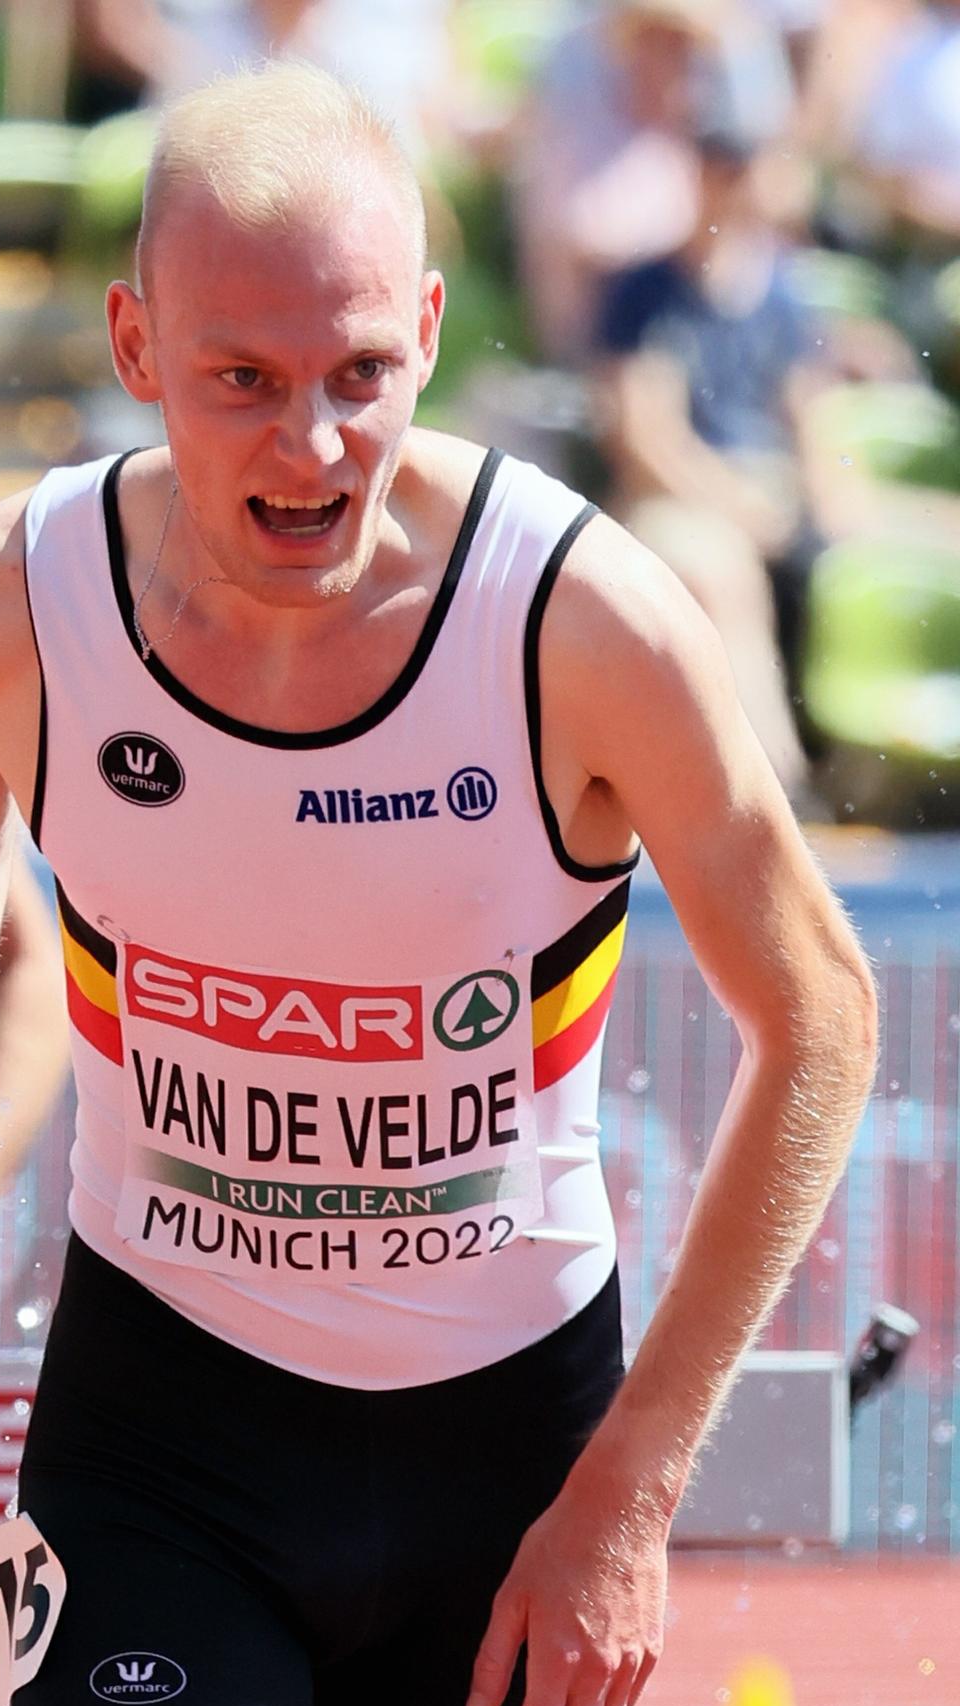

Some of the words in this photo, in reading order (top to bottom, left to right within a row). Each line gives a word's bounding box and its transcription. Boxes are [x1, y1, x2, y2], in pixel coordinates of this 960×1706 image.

[111, 772, 171, 795] vermarc
[295, 788, 439, 824] Allianz
[132, 957, 414, 1051] SPAR
[131, 1048, 227, 1157] VAN
[246, 1086, 321, 1166] DE
[337, 1067, 519, 1170] VELDE
[211, 1174, 219, 1199] I
[228, 1181, 302, 1215] RUN
[141, 1195, 357, 1271] MUNICH
[381, 1214, 515, 1269] 2022
[102, 1683, 171, 1695] vermarc
